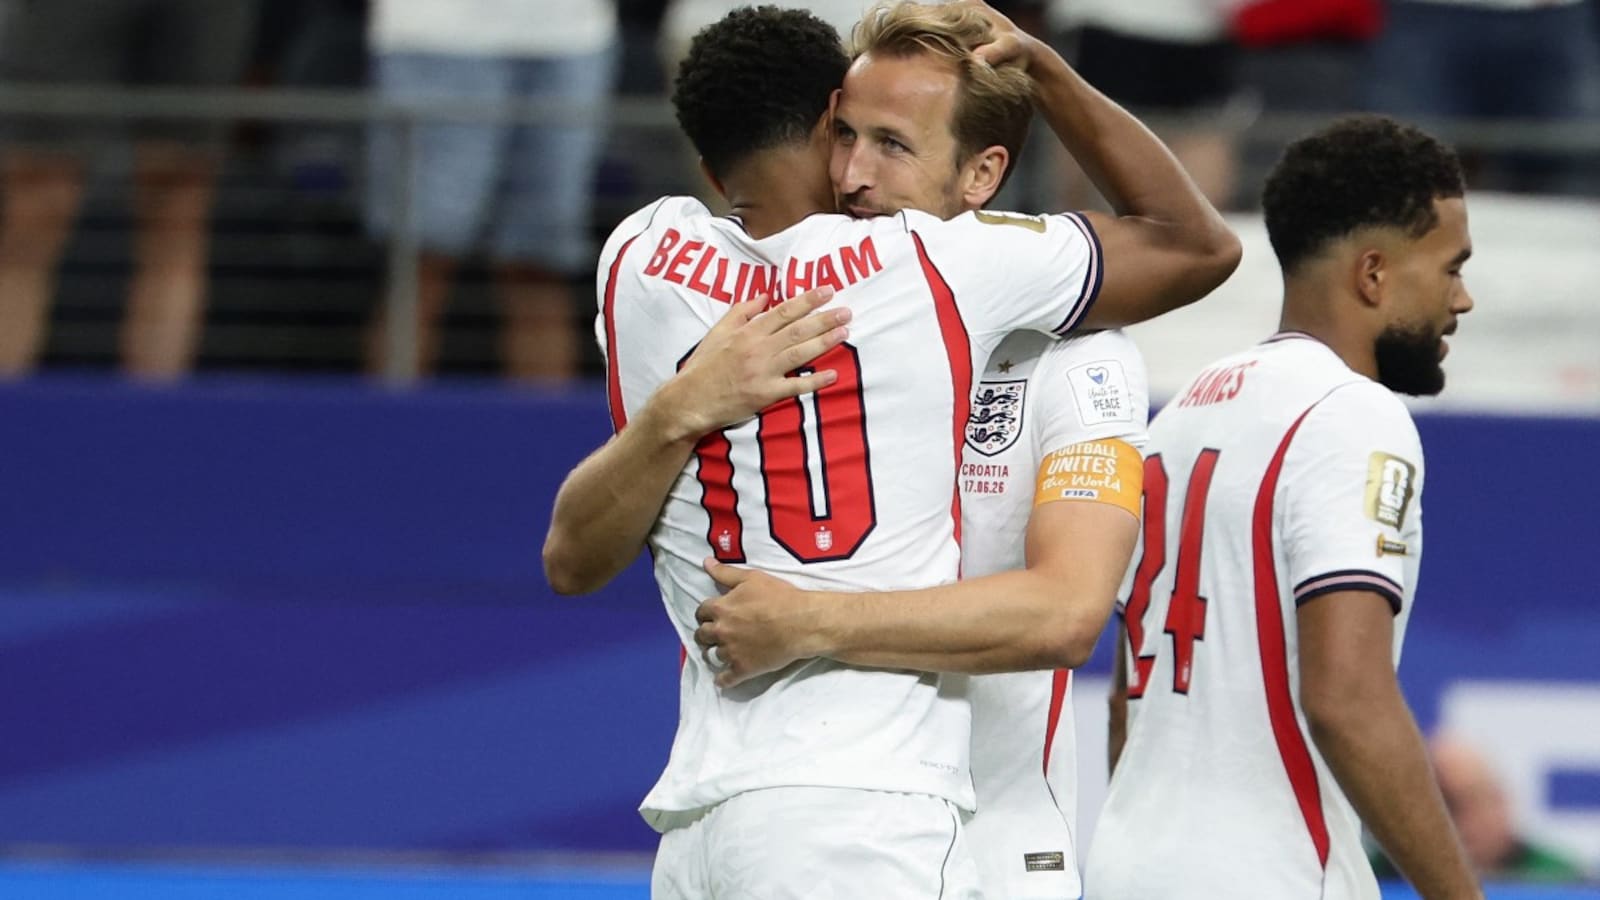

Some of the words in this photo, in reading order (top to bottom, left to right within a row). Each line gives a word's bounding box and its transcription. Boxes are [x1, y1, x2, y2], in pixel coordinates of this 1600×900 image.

[643, 228, 883, 311] BELLINGHAM
[1178, 359, 1257, 408] JAMES
[1093, 397, 1121, 411] PEACE
[676, 340, 877, 564] 10
[962, 463, 1009, 478] CROATIA
[1047, 455, 1117, 475] UNITES
[964, 479, 1005, 494] 17.06.26
[1042, 474, 1068, 490] the
[1071, 474, 1121, 493] World
[1064, 489, 1096, 498] FIFA
